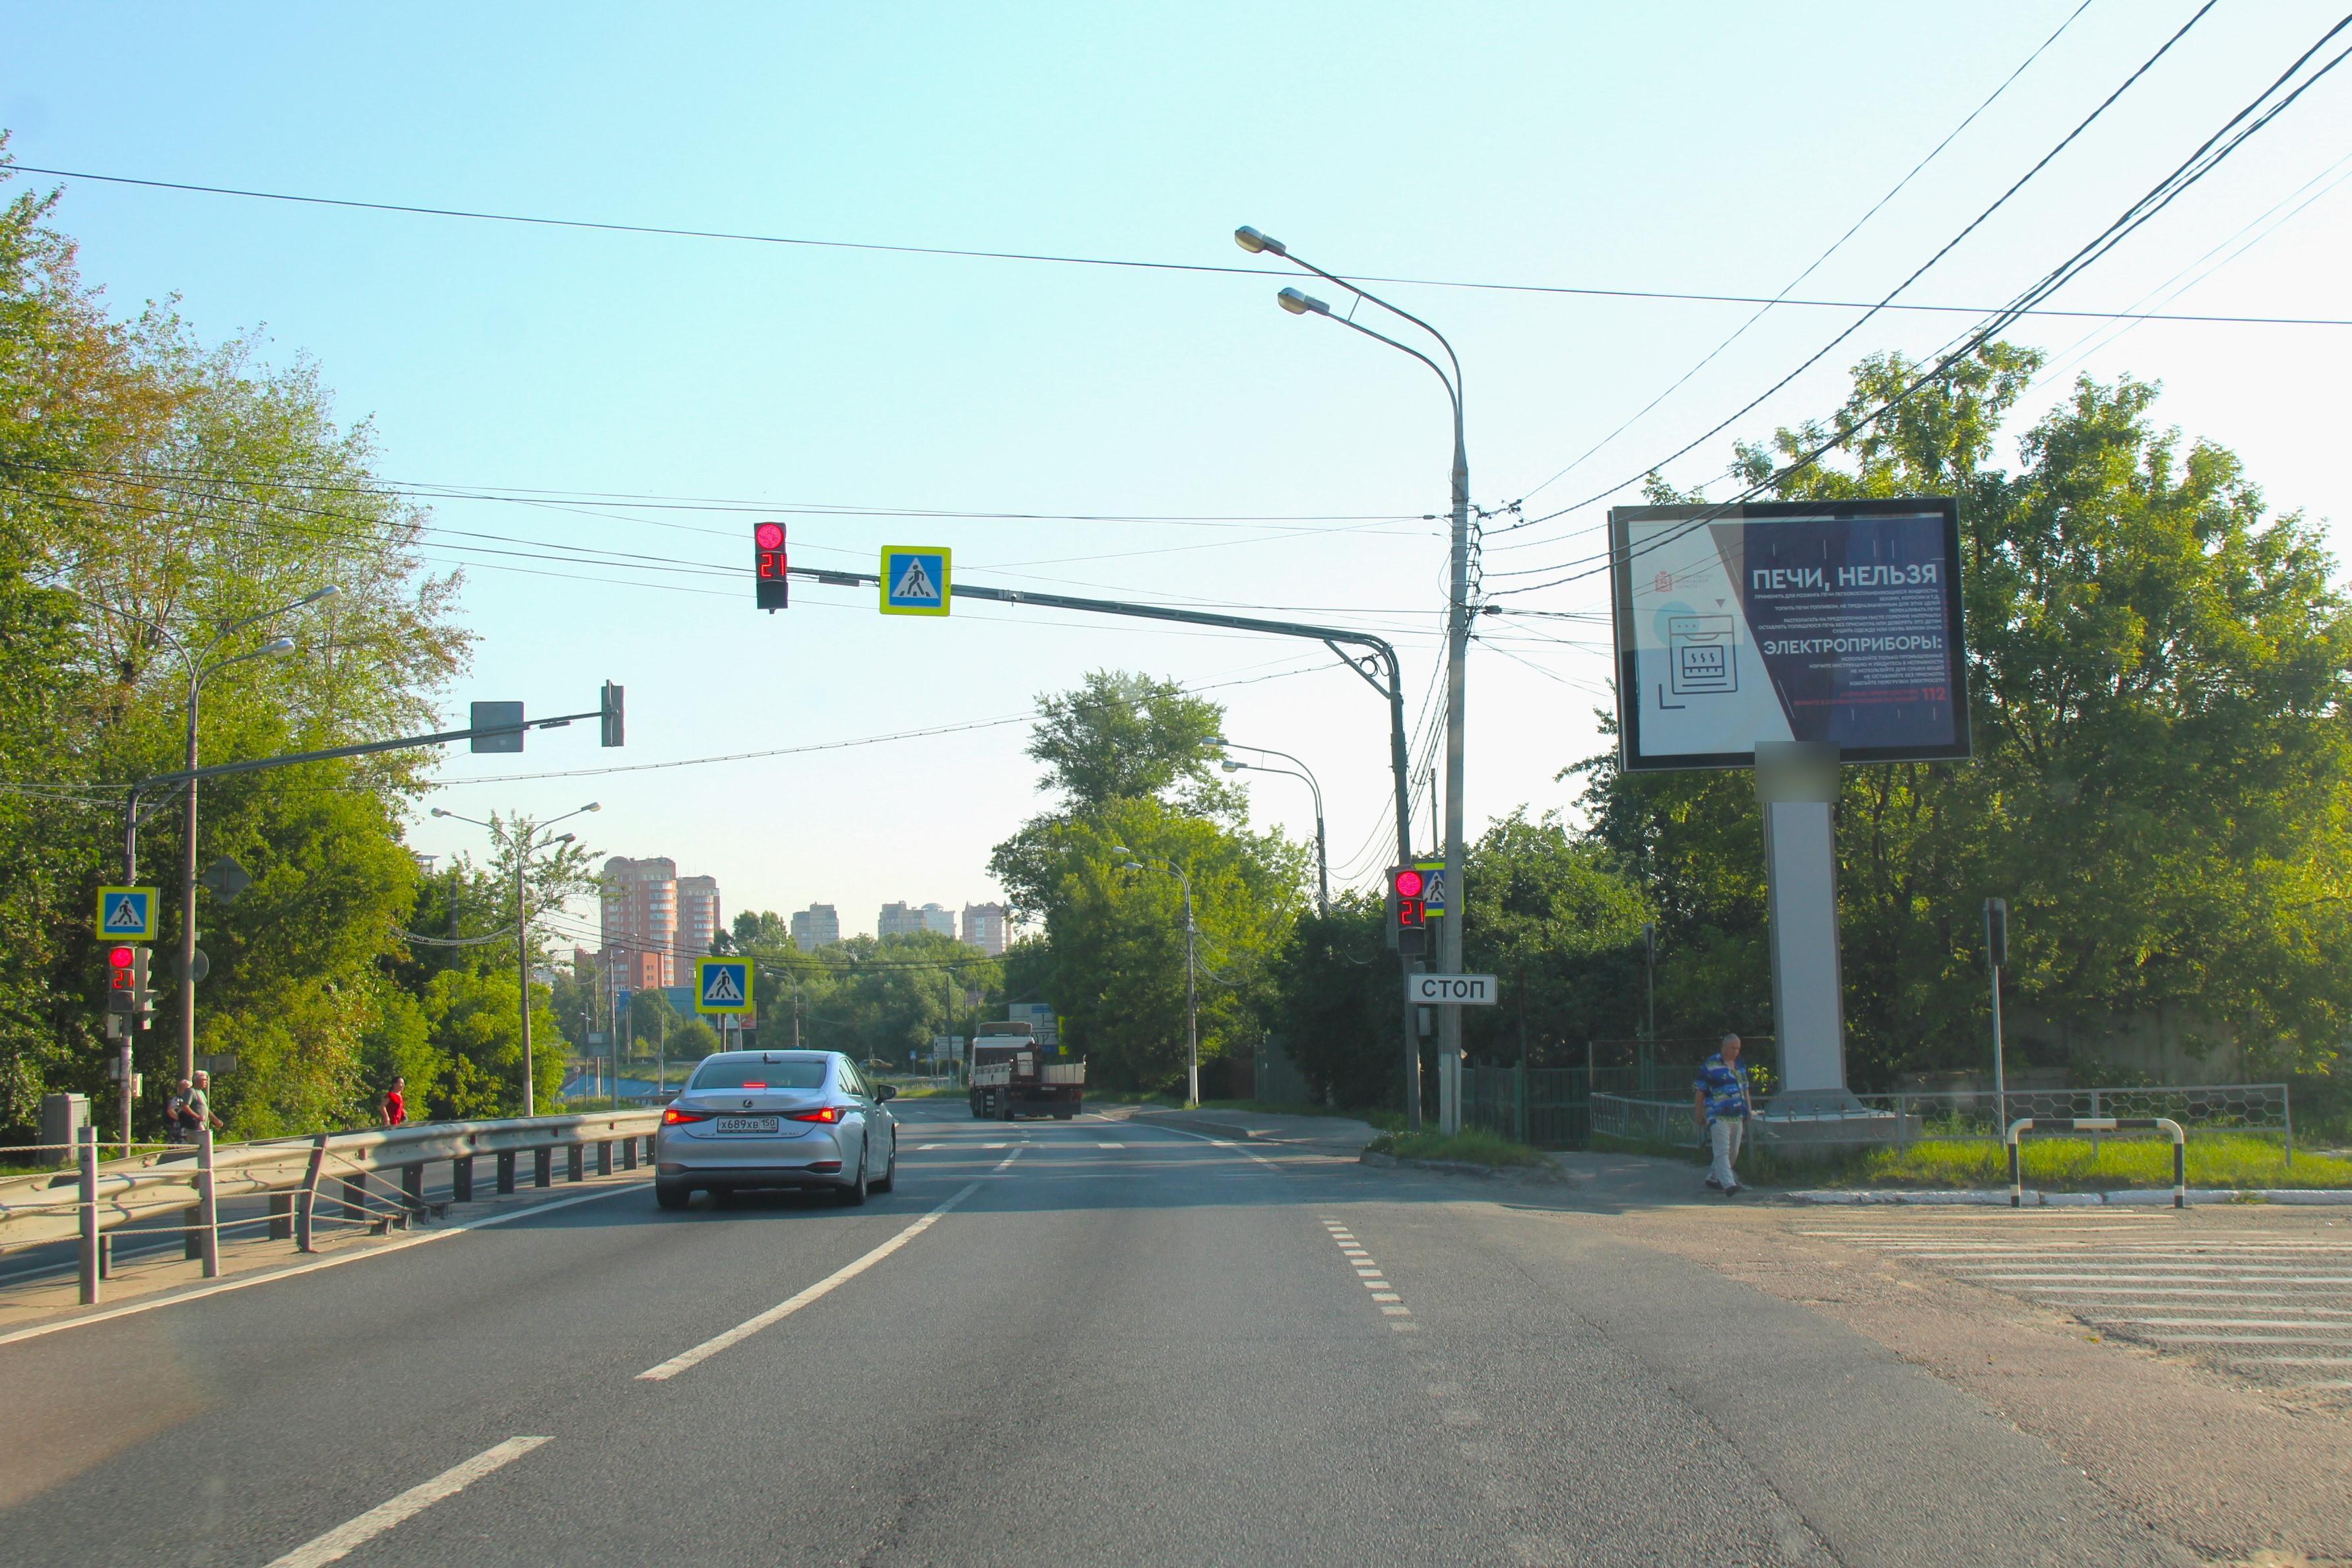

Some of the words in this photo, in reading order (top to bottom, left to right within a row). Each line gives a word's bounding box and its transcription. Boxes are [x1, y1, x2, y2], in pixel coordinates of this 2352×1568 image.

[761, 554, 786, 577] 21
[1753, 568, 1830, 592] ПЕЧИ,
[1838, 564, 1937, 587] НЕЛЬЗЯ
[1763, 636, 1943, 655] ЭЛЕКТРОПРИБОРЫ:
[1921, 687, 1947, 702] 112
[1401, 901, 1425, 924] 21
[113, 970, 134, 989] 21
[1421, 979, 1484, 998] СТОП
